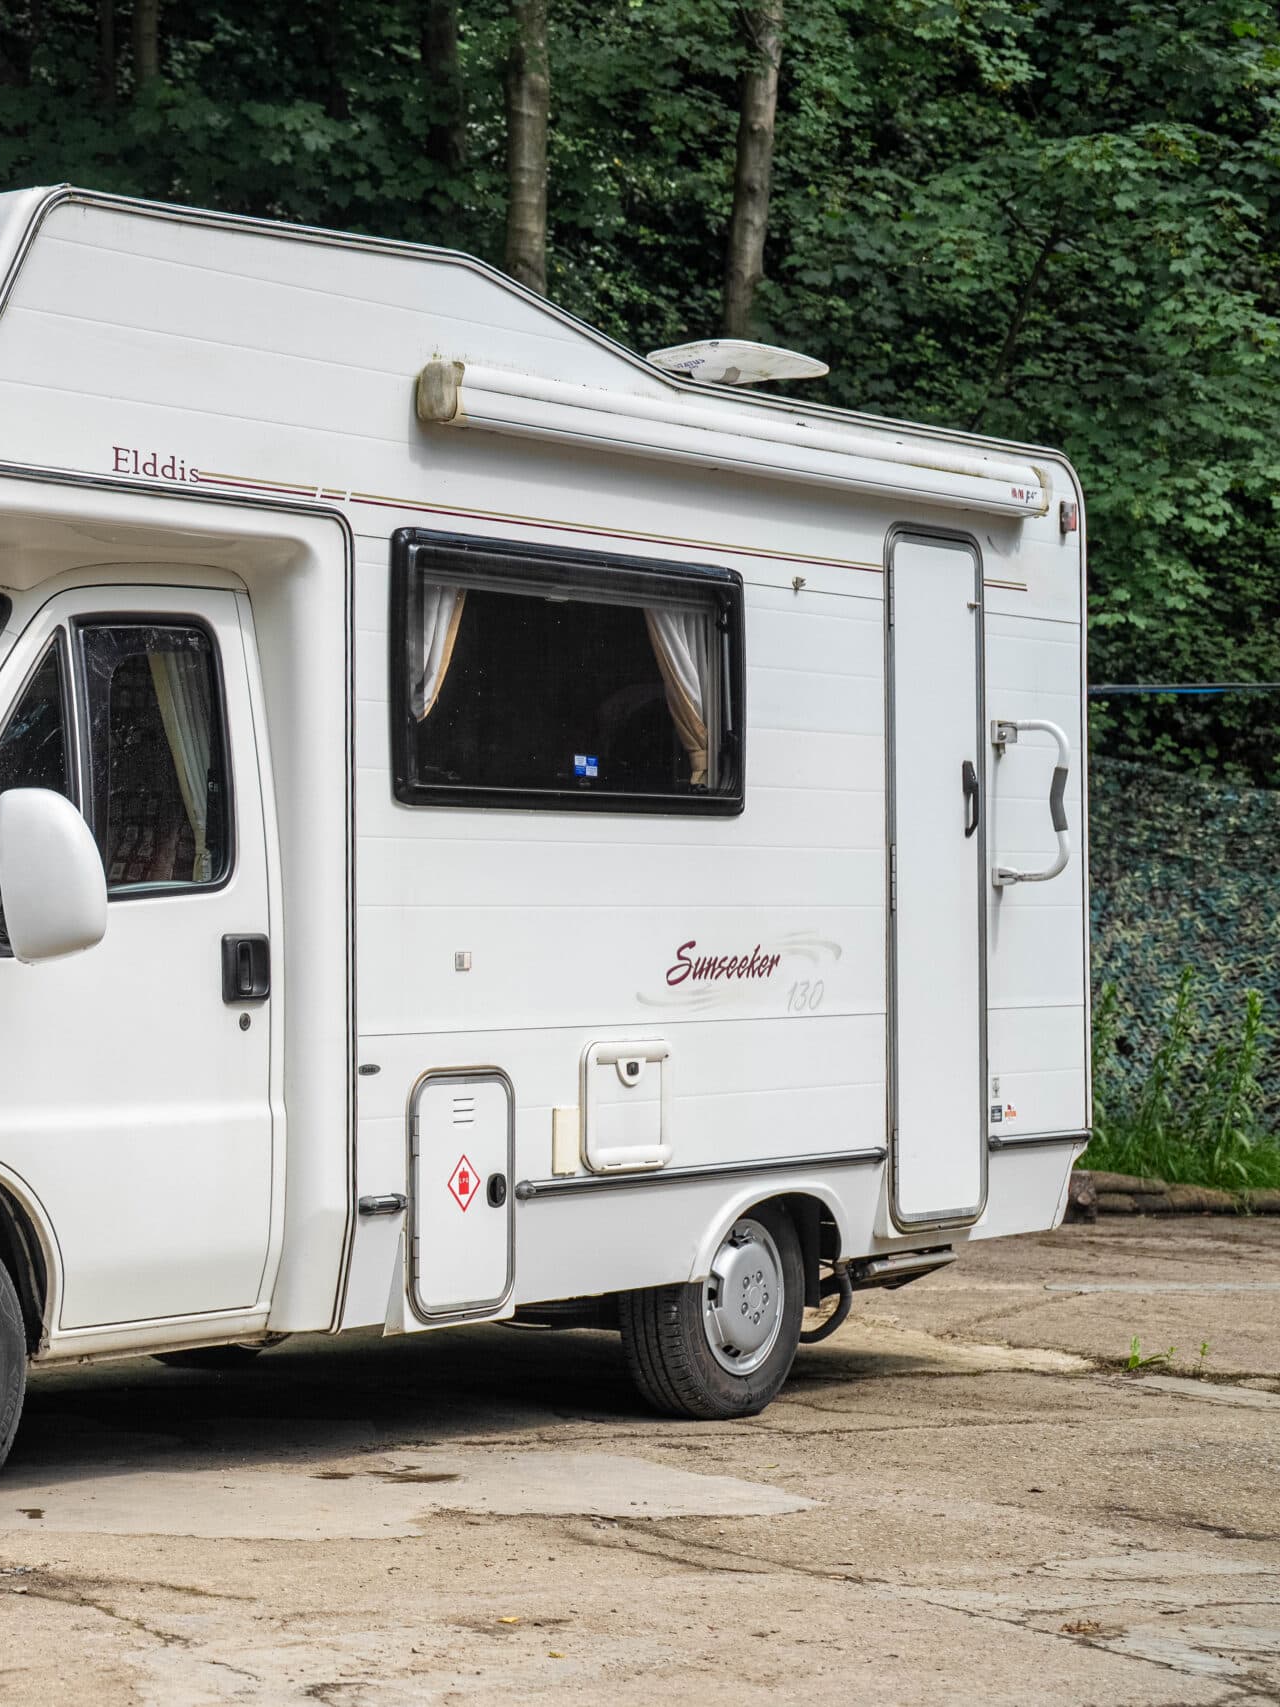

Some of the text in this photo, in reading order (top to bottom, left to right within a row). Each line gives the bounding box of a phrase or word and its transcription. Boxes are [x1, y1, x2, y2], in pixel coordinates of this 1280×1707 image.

[112, 446, 199, 483] Elddis
[666, 940, 781, 986] Sunseeker
[787, 979, 824, 1012] 130
